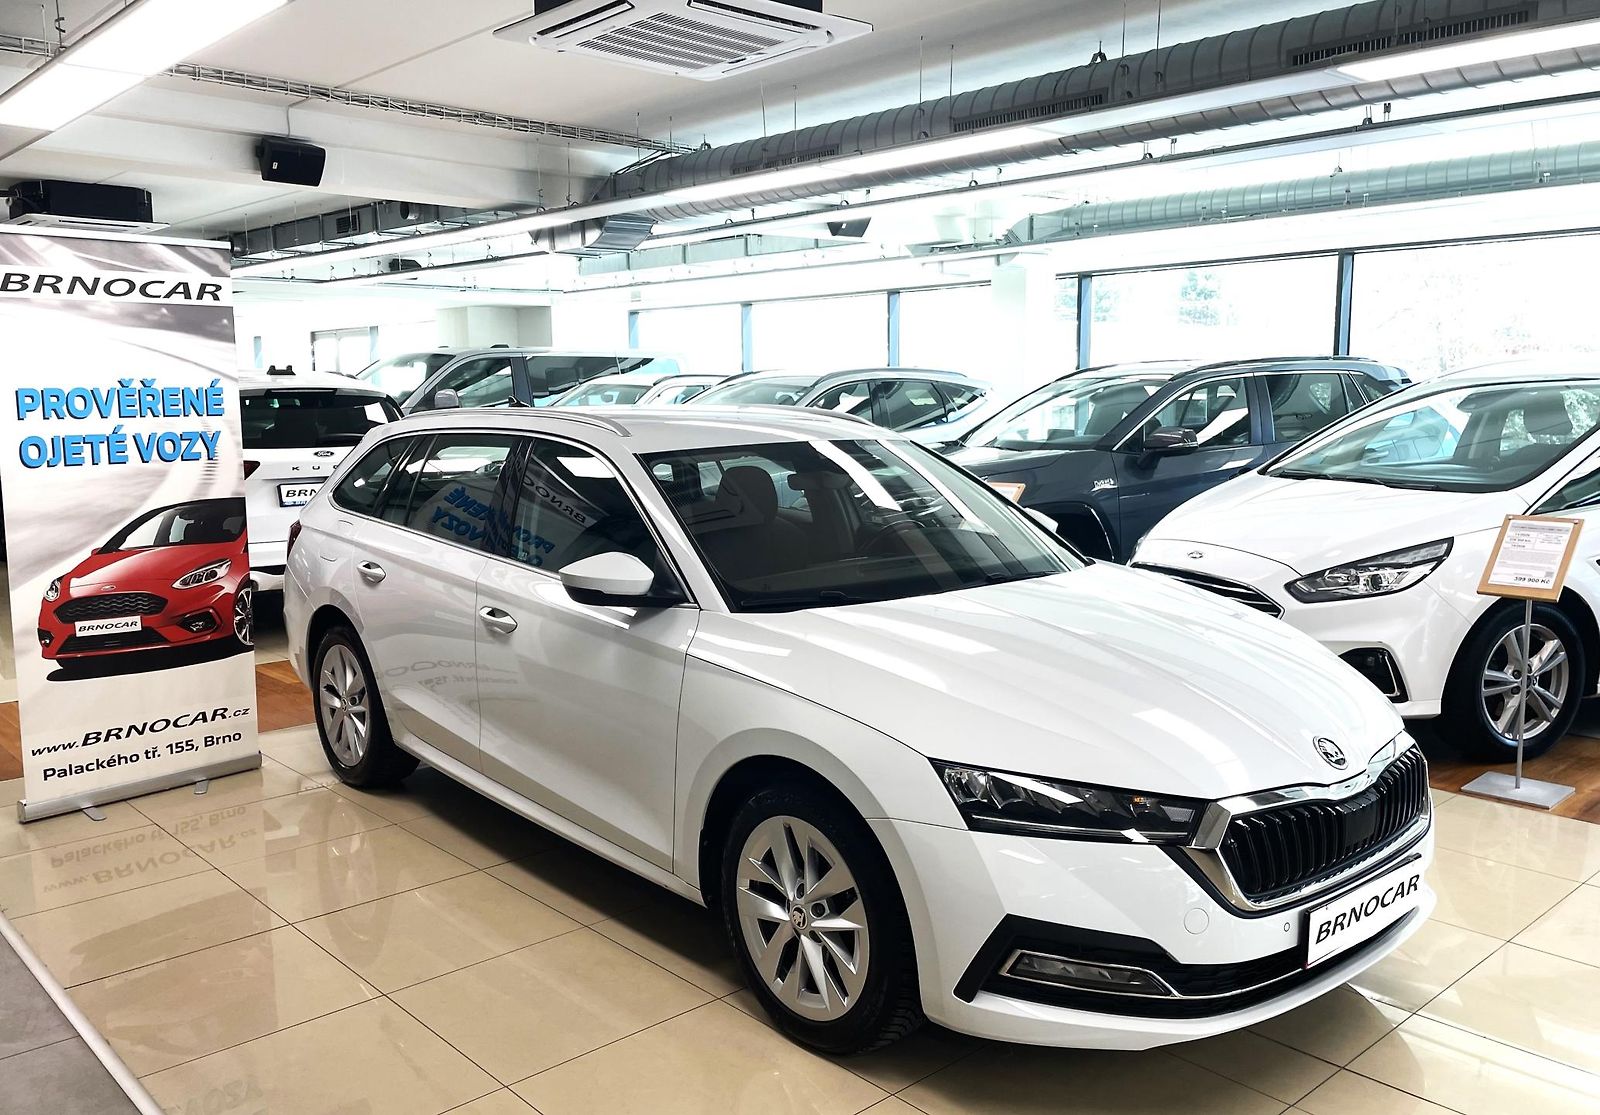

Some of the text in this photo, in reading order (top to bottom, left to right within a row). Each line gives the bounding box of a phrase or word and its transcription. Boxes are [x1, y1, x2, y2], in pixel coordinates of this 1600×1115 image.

[0, 272, 223, 302] BRNOCAR
[16, 378, 225, 420] PROVĚŘENÉ
[19, 424, 222, 469] OJETÉ VOZY
[78, 619, 139, 633] BRNOCAR
[31, 706, 251, 757] www.BRNOCAR.cz
[42, 731, 242, 781] Palackého tř. 155, Brno
[1315, 873, 1421, 945] BRNOCAR
